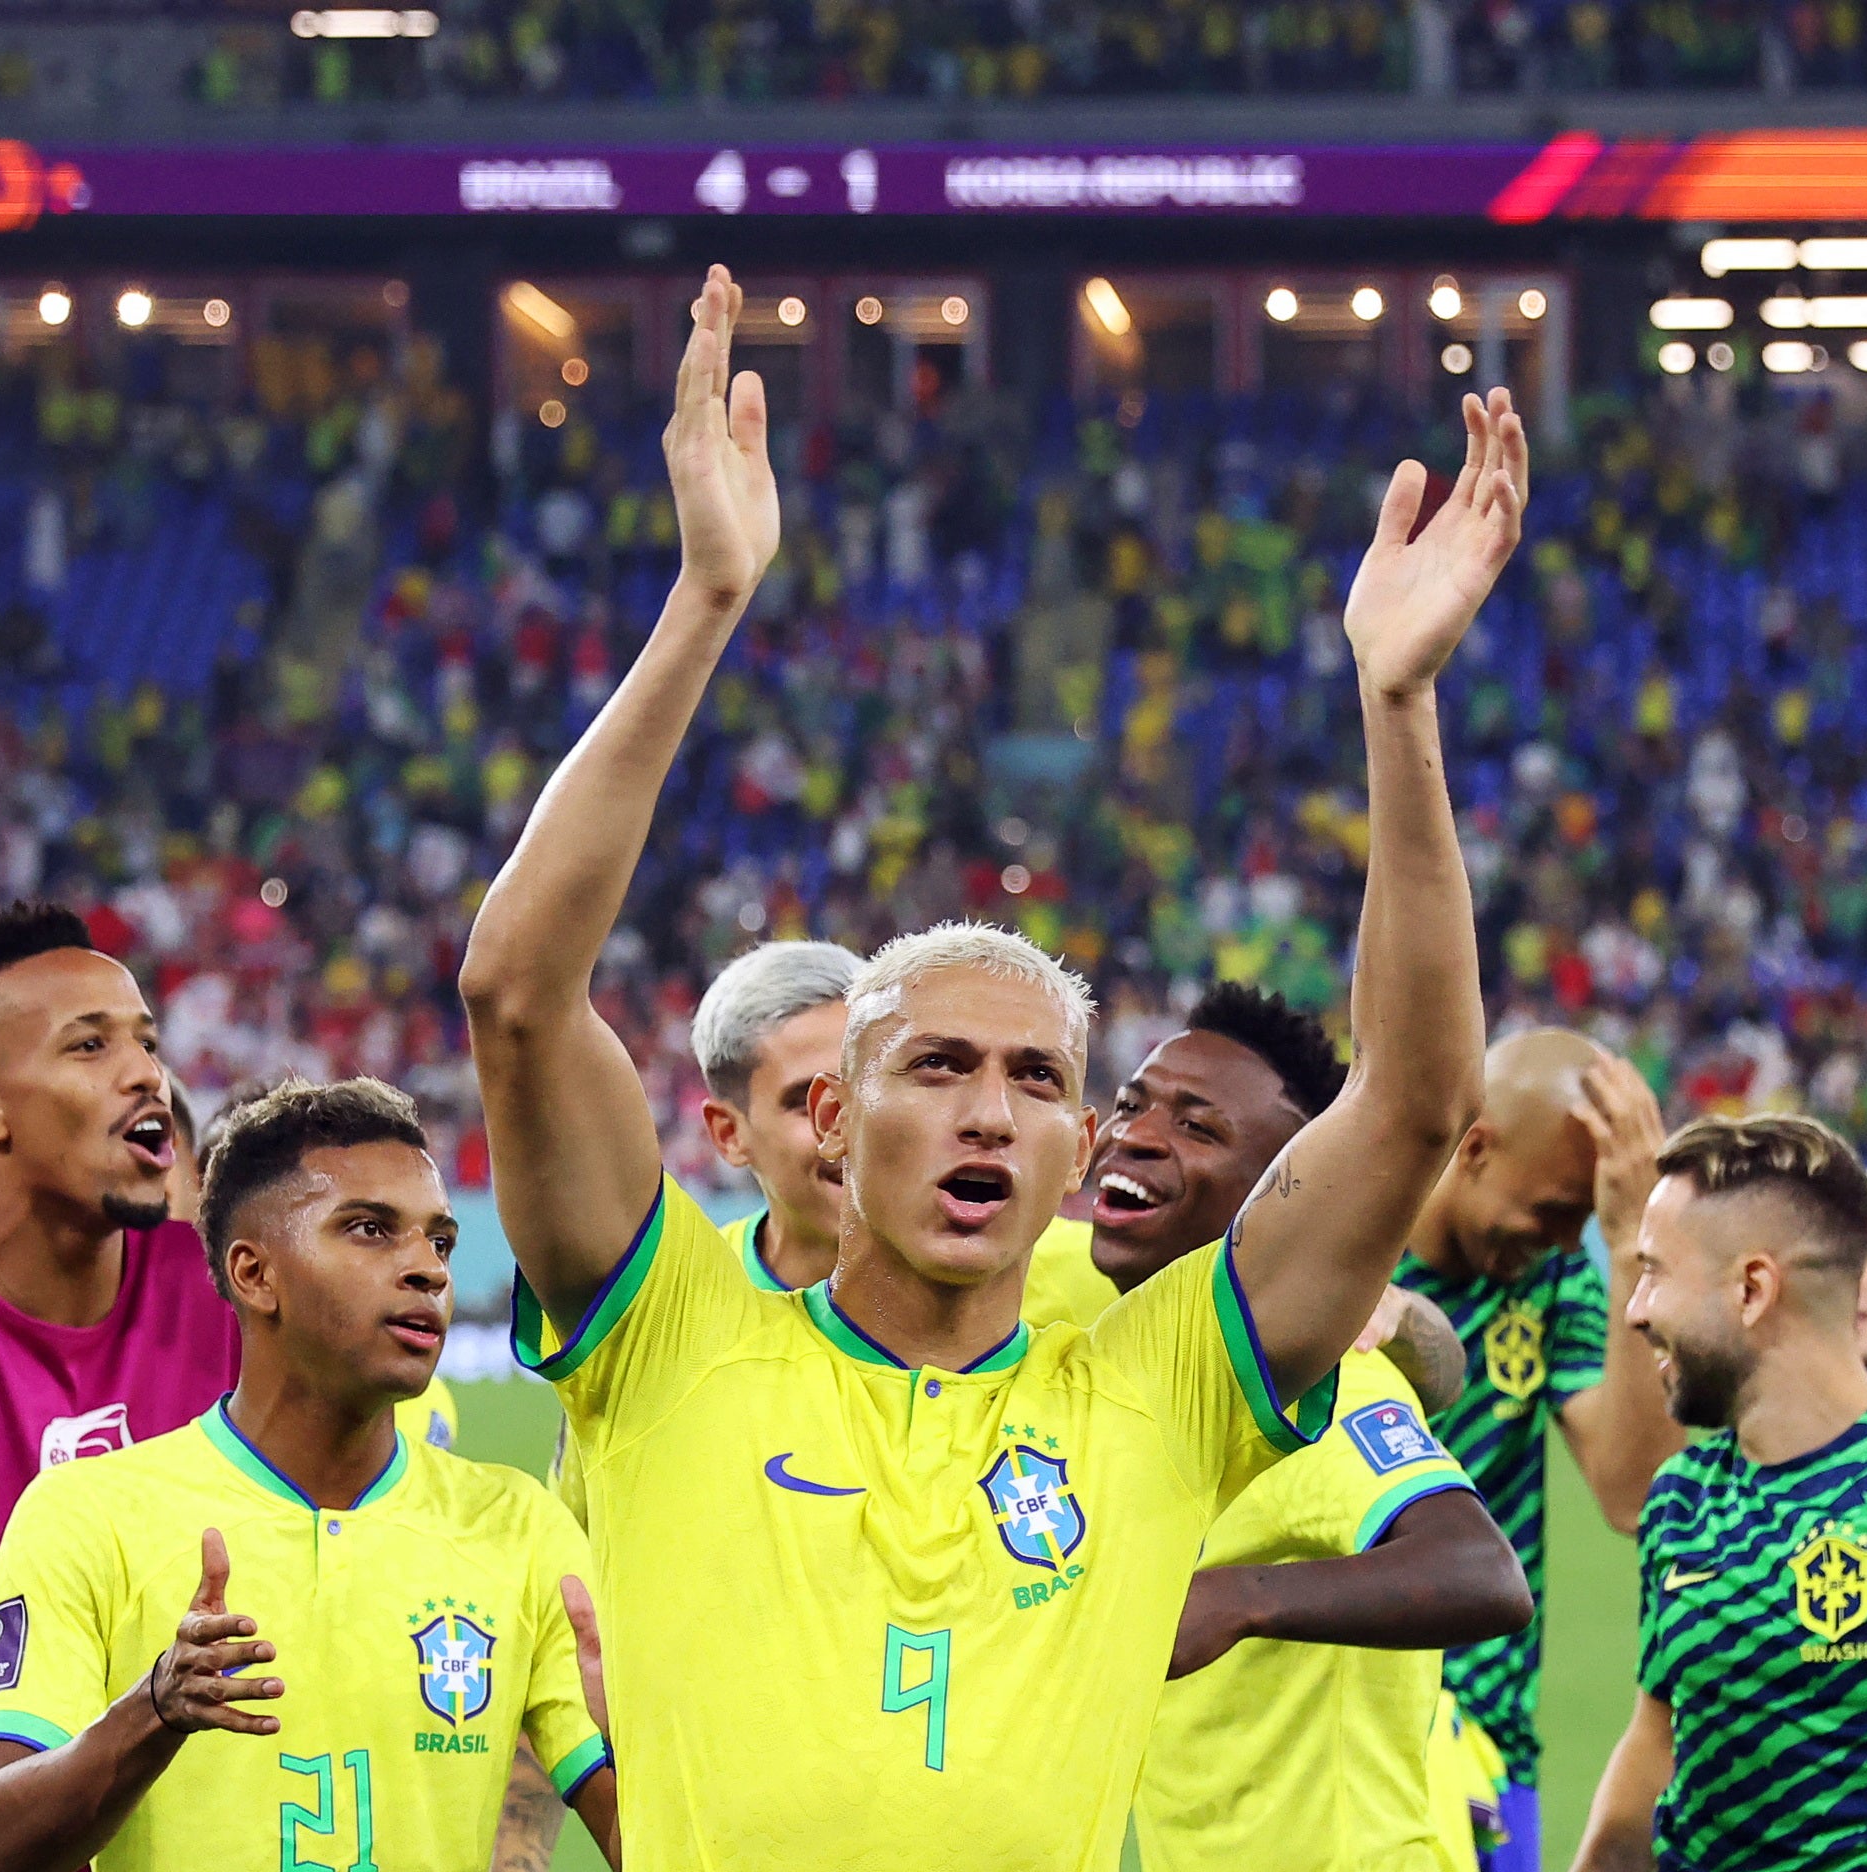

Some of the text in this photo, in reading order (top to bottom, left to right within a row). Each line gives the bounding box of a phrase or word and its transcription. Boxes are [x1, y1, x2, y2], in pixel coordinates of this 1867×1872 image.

[694, 149, 748, 214] 4
[839, 149, 879, 214] 1
[1016, 1494, 1049, 1516] CBF
[1012, 1563, 1086, 1611] BRAS
[441, 1659, 471, 1673] CBF
[881, 1621, 951, 1774] 9
[414, 1732, 490, 1754] BRASIL
